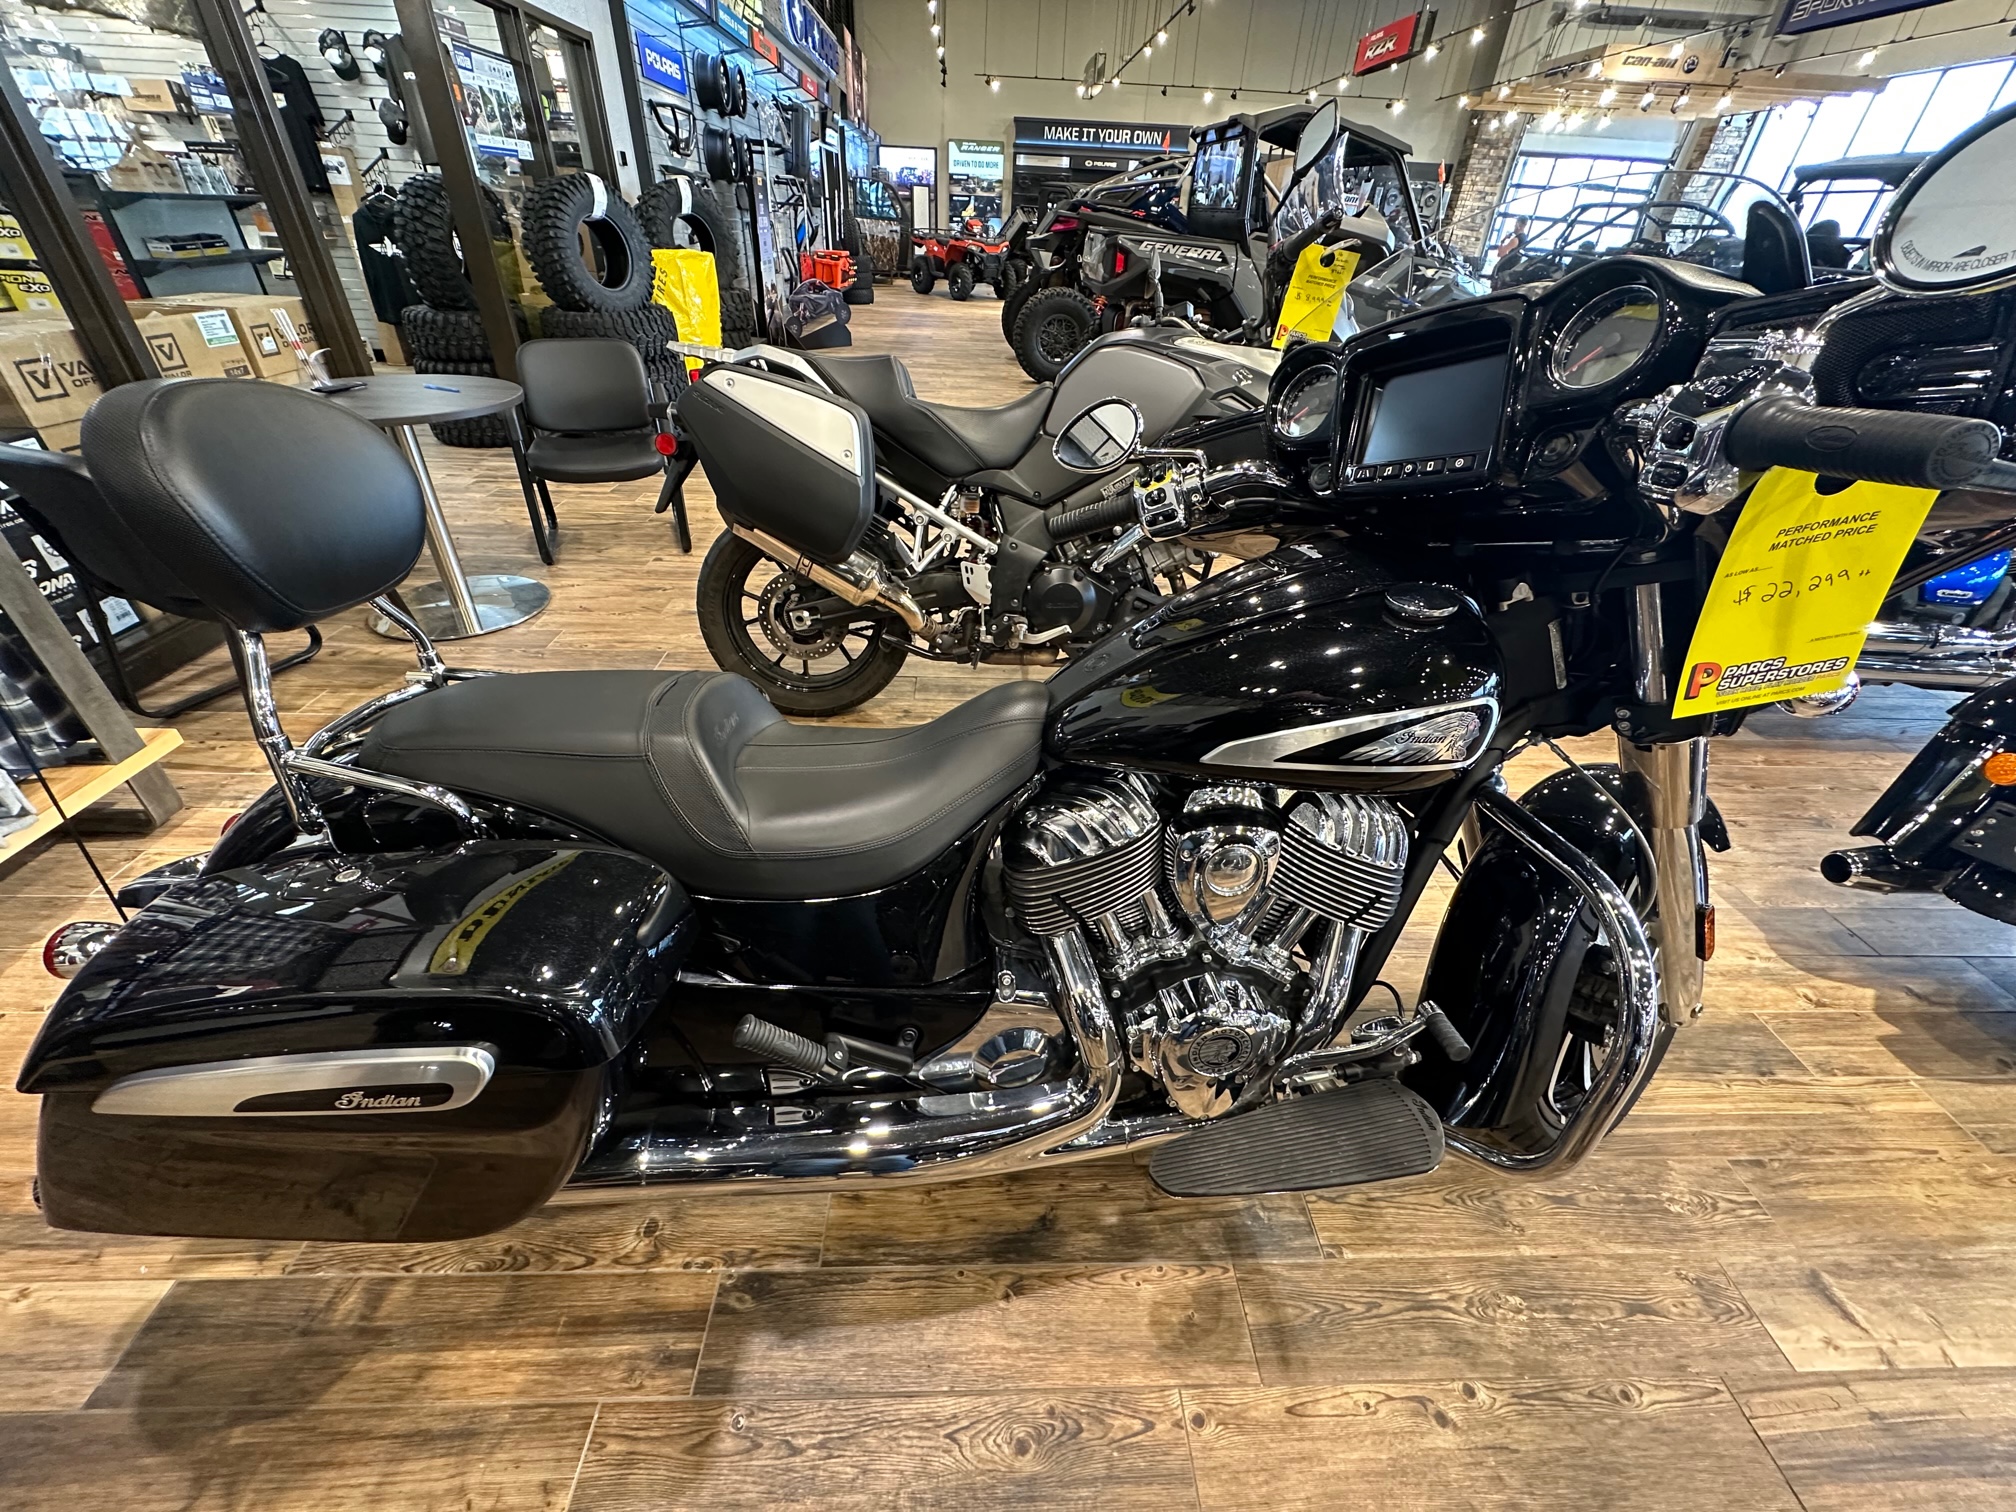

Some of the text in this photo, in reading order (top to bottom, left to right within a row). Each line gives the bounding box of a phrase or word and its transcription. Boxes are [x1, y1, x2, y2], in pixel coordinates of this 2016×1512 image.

[1364, 34, 1399, 61] RZR
[645, 47, 682, 80] POLARIS
[1622, 55, 1679, 69] can-am
[1044, 126, 1163, 146] MAKE IT YOUR OWN
[953, 160, 971, 168] DRIVEN
[985, 161, 1000, 169] MORE
[1139, 241, 1223, 262] GENERAL
[1951, 261, 1971, 273] ARE
[1969, 252, 2009, 271] CLOSER
[19, 283, 51, 292] EXO
[1776, 510, 1883, 538] PERFORMANCE
[1768, 523, 1879, 552] MATCHED PRICE
[1734, 568, 1750, 577] LOW
[1717, 657, 1850, 692] SUPERSTORES
[1722, 656, 1787, 680] PARCS
[1716, 698, 1730, 706] VISIT
[1740, 694, 1762, 702] ONLINE
[1395, 730, 1447, 744] Indian
[335, 1091, 421, 1111] Indian
[1411, 1098, 1437, 1131] Indian
